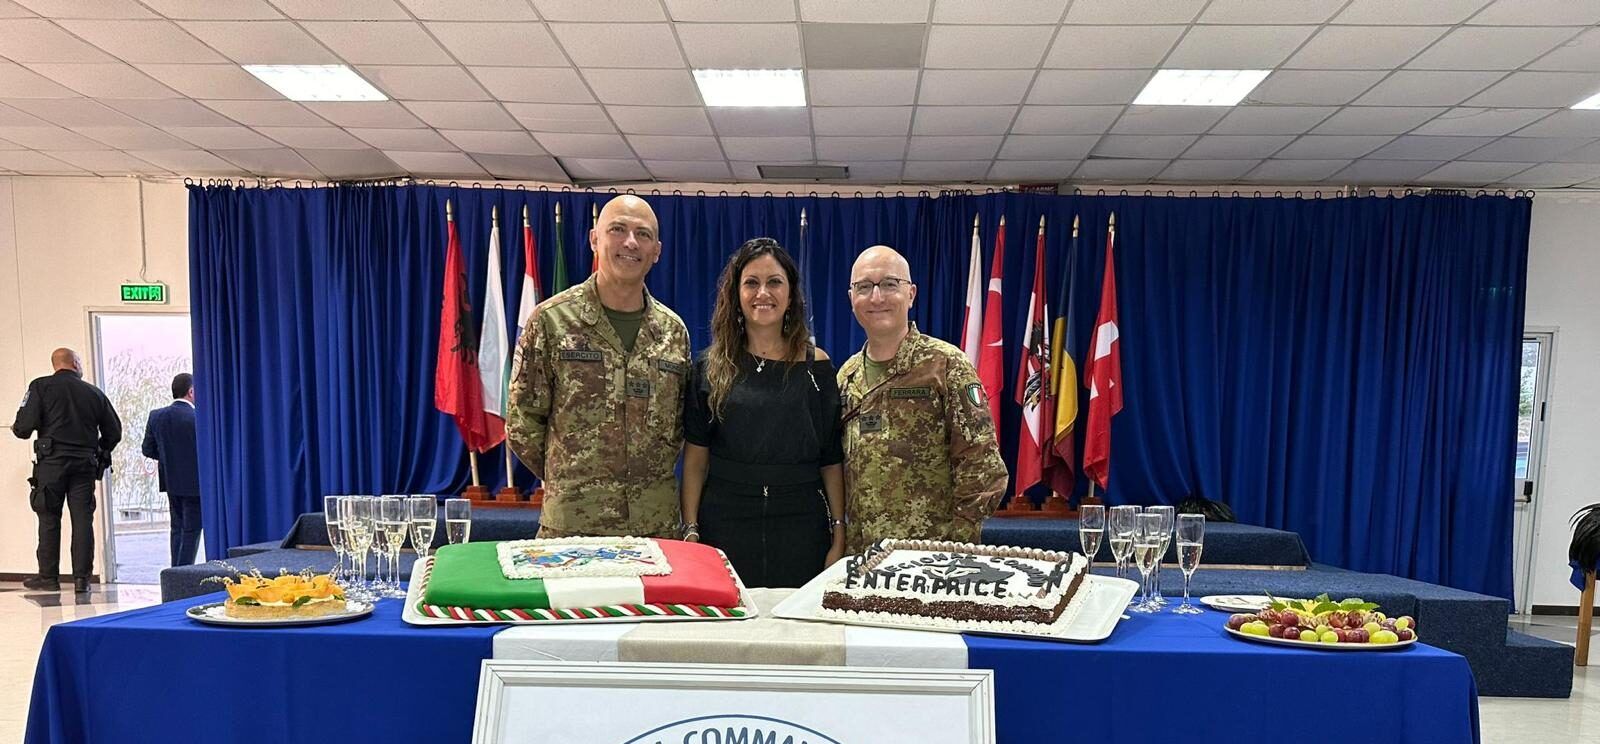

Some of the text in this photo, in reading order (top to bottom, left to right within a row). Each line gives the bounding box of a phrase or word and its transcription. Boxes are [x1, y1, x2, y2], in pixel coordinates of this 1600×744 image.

[123, 287, 149, 299] EXIT
[562, 351, 600, 359] ESERCITO
[845, 572, 1009, 599] ENTERPRICE
[683, 727, 808, 744] COMM
